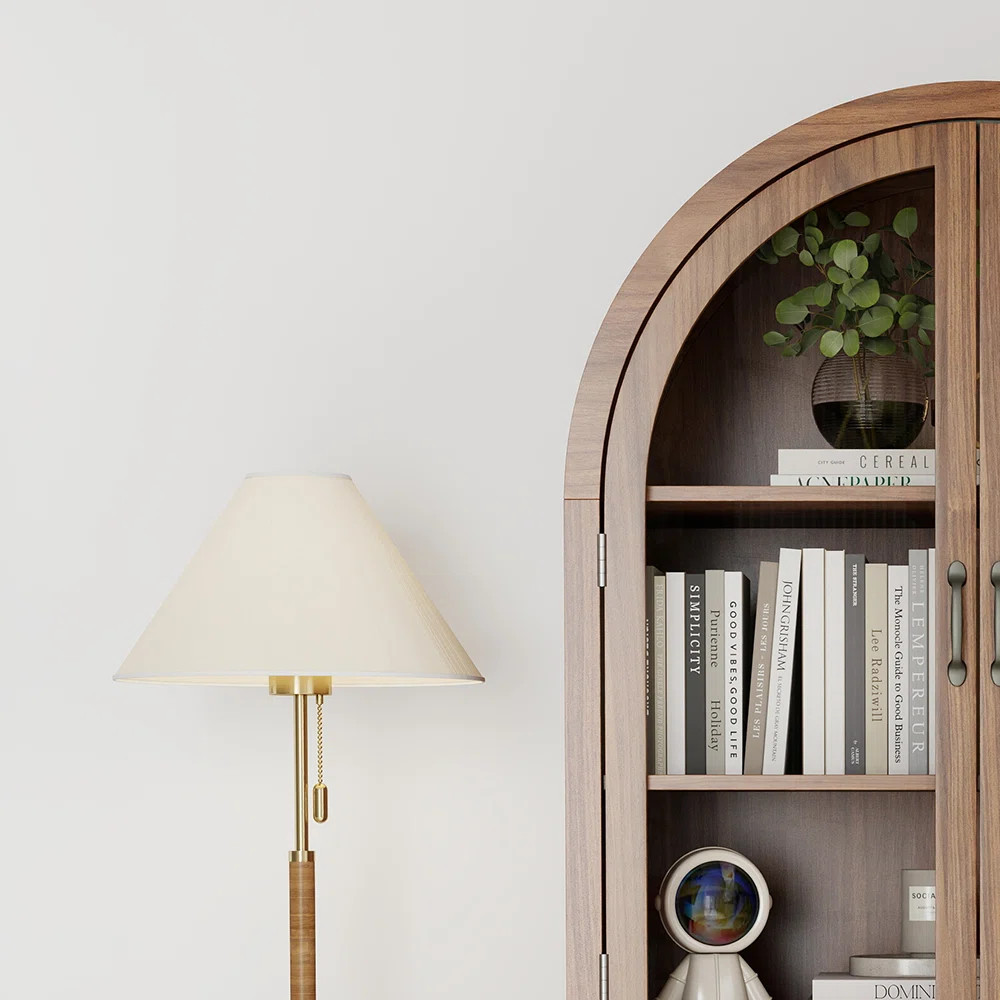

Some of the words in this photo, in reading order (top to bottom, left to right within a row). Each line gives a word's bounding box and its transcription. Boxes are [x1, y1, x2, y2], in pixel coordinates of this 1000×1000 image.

[859, 454, 930, 469] CEREAL
[894, 586, 903, 605] The
[690, 585, 700, 675] SIMPLICITY
[729, 601, 738, 639] GOOD
[761, 603, 770, 631] JOURS
[894, 609, 903, 649] Monocle
[710, 610, 721, 668] Purienne
[760, 634, 768, 652] LES
[872, 629, 882, 652] Lee
[894, 651, 904, 680] Guide
[911, 602, 925, 753] LEMPEREUR
[755, 663, 765, 714] PLAISIRS
[872, 658, 882, 722] Radziwill
[894, 683, 902, 692] to
[894, 694, 904, 721] Good
[708, 700, 721, 752] Holiday
[753, 718, 761, 739] LES
[729, 731, 738, 758] LIFE
[894, 724, 903, 763] Business
[911, 892, 936, 900] SOCIA
[875, 984, 936, 1000] DOMINI
